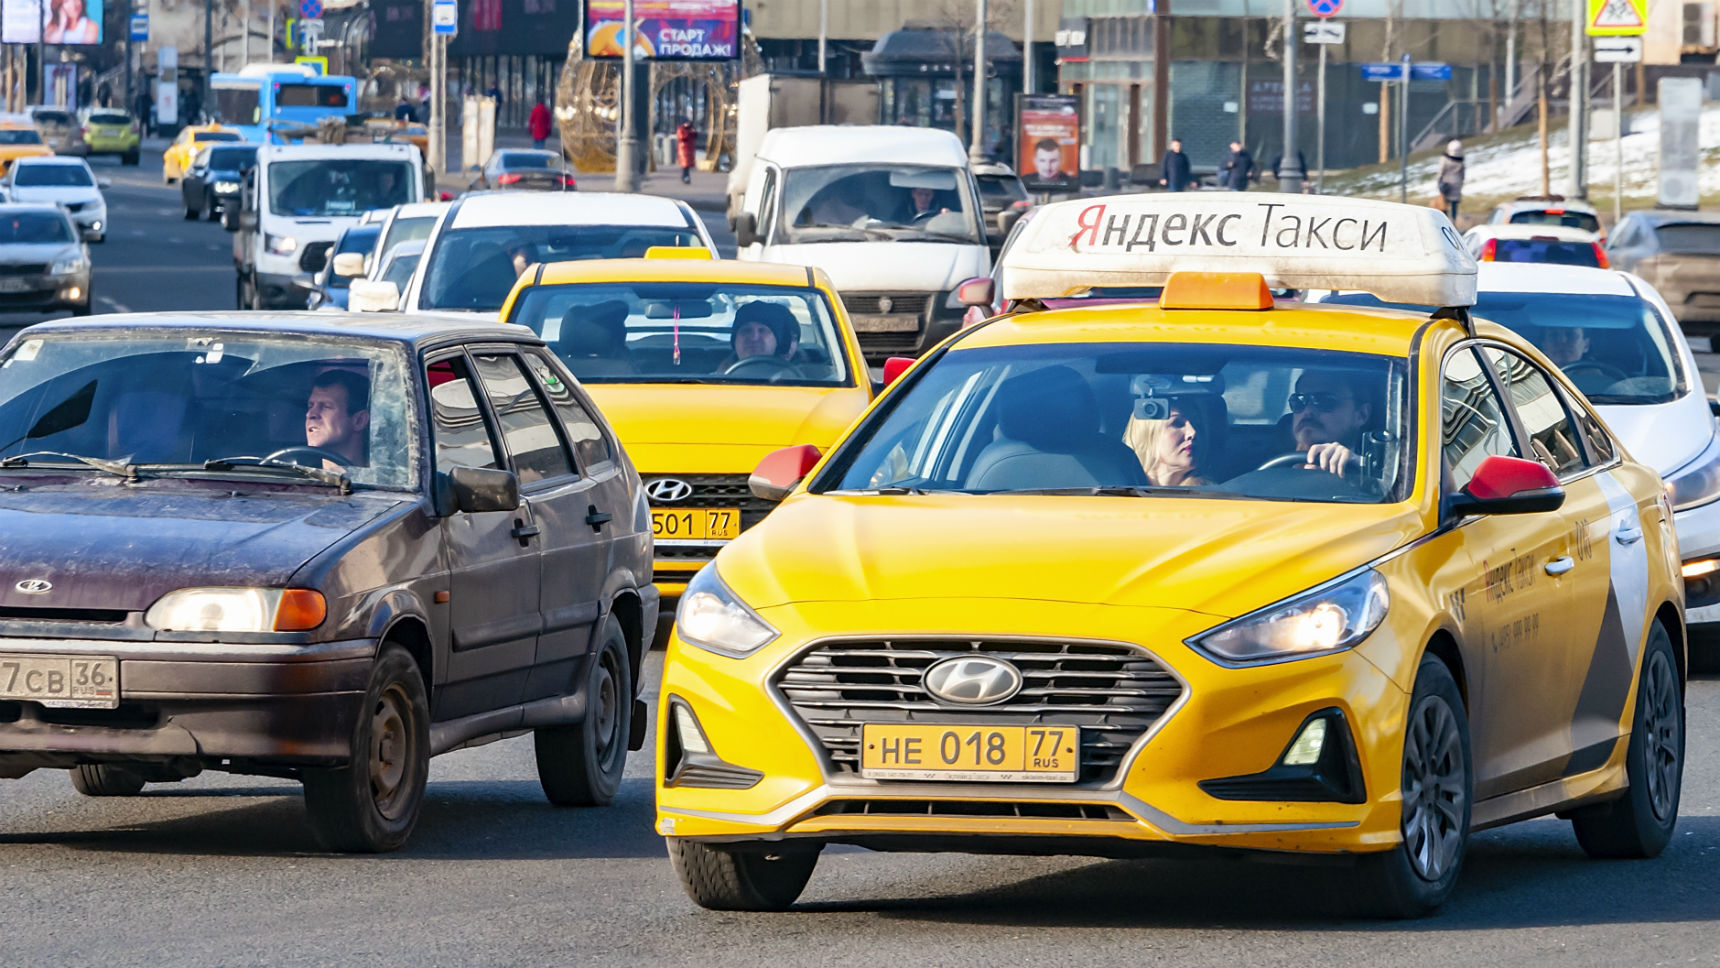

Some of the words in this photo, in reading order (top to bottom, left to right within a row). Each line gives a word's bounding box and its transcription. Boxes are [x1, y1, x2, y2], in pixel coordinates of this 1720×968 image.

[659, 28, 705, 42] СТАРТ
[659, 43, 732, 57] ПРОДАЖ!
[1068, 204, 1242, 253] Яндекс
[1257, 203, 1388, 253] Такси
[652, 513, 693, 535] 501
[709, 512, 731, 529] 77
[75, 663, 105, 686] 36
[73, 686, 95, 695] RUS
[881, 737, 922, 764] НЕ
[940, 731, 1006, 765] 018
[1030, 731, 1064, 757] 77
[1033, 758, 1059, 768] RUS
